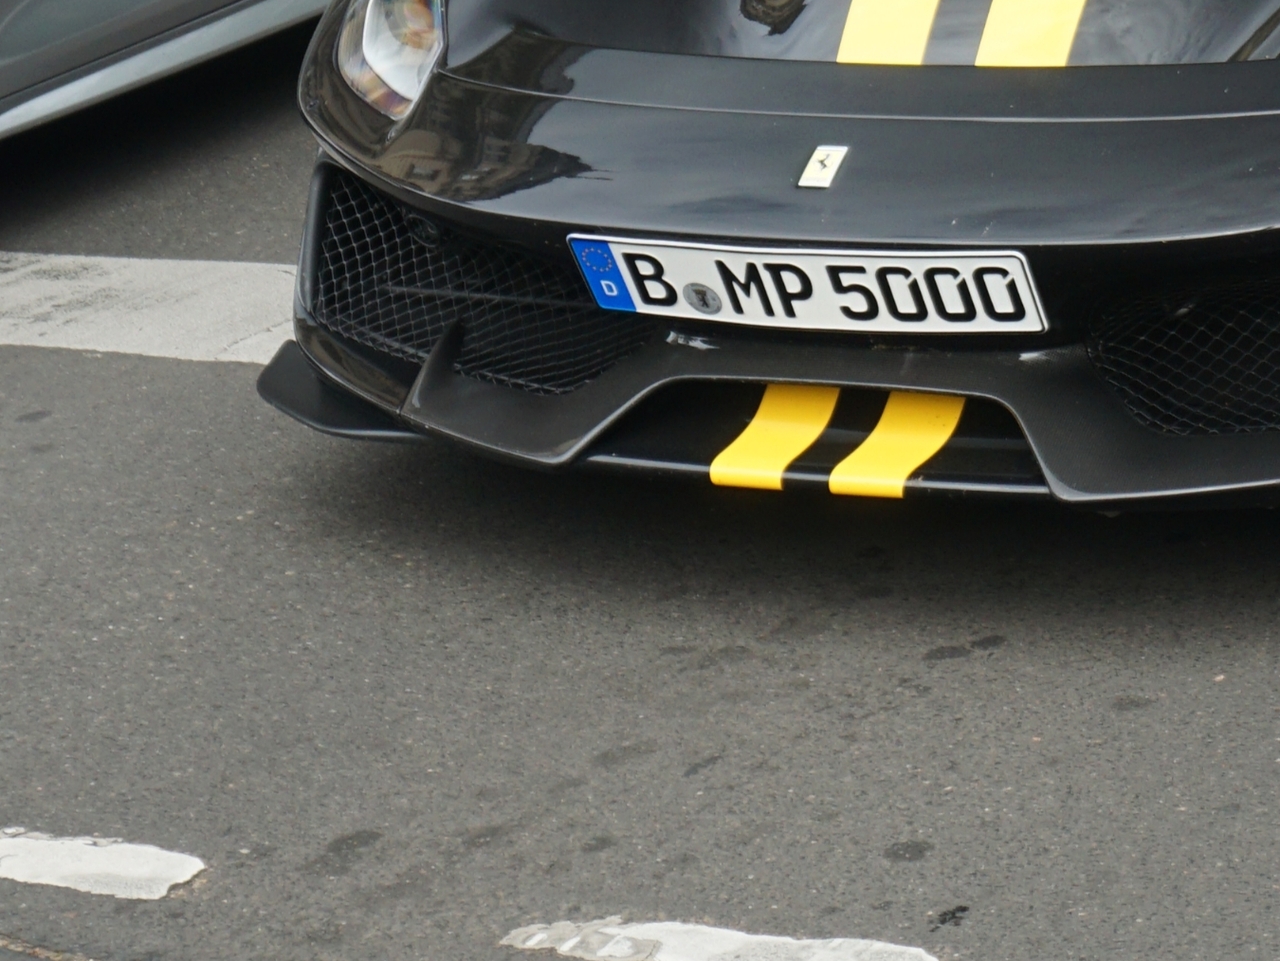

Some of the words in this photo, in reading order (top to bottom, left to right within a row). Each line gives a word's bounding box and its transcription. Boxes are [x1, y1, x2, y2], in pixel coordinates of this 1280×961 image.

[601, 280, 618, 296] D
[621, 252, 678, 307] B
[714, 259, 814, 319] MP
[825, 265, 1027, 323] 5000
